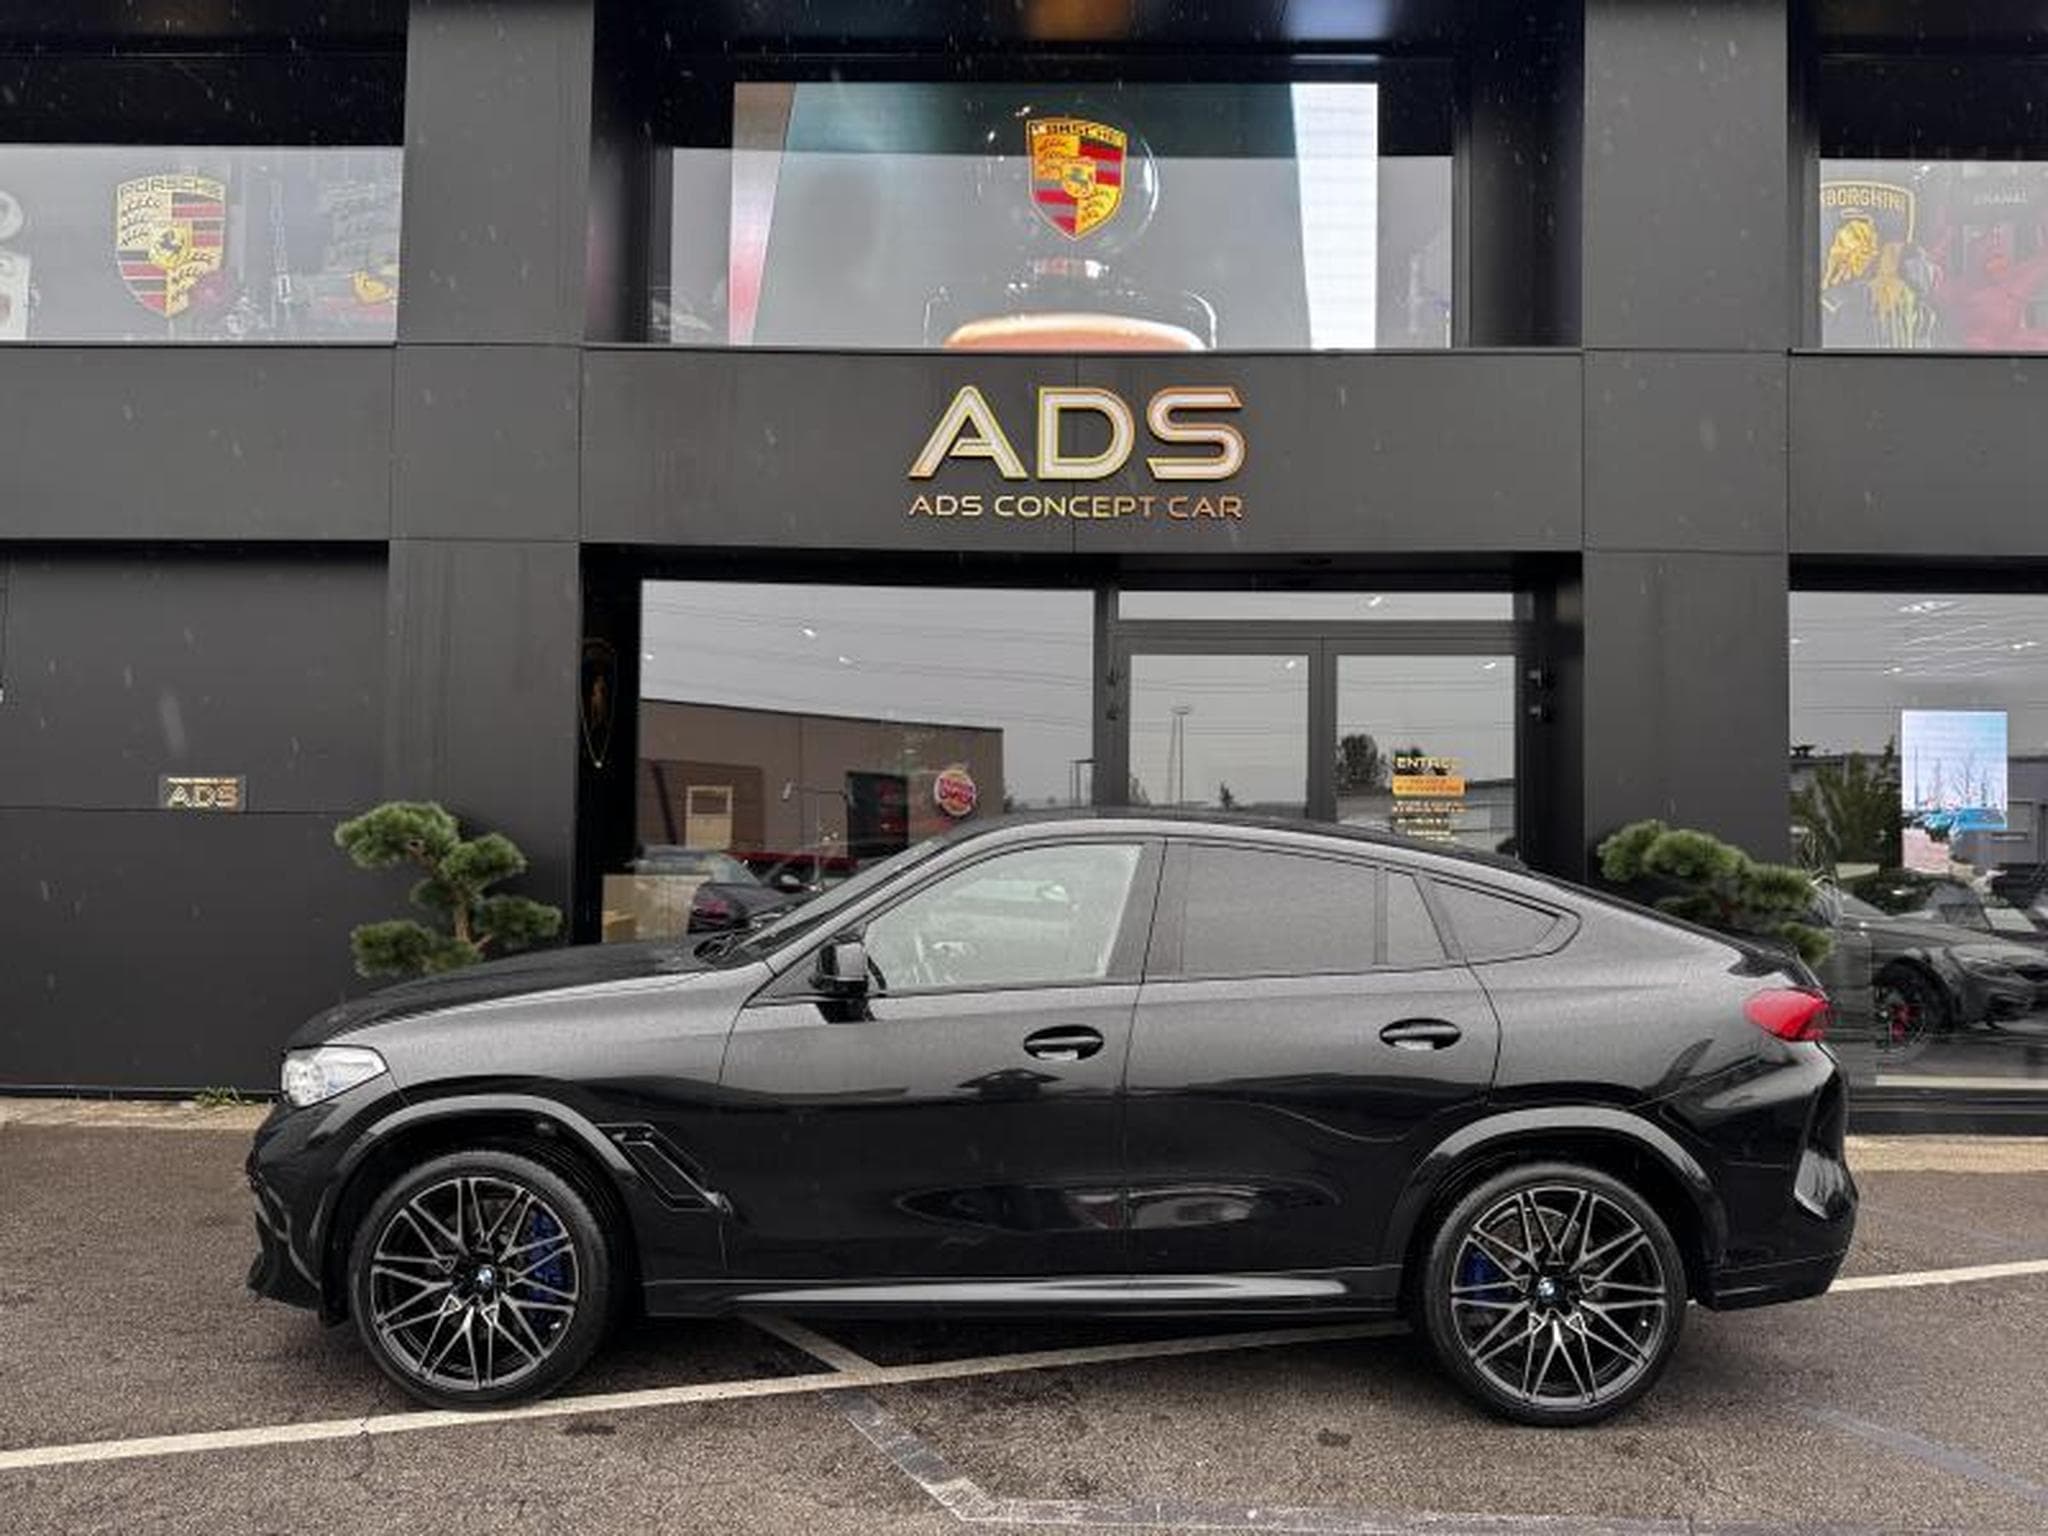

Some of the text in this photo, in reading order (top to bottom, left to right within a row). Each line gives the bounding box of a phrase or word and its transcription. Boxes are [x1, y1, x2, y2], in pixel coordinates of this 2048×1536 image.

[1821, 186, 1906, 209] BORGHINI
[908, 385, 1246, 480] ADS
[909, 495, 1243, 518] ADS CONCEPT CAR
[167, 785, 239, 808] ADS
